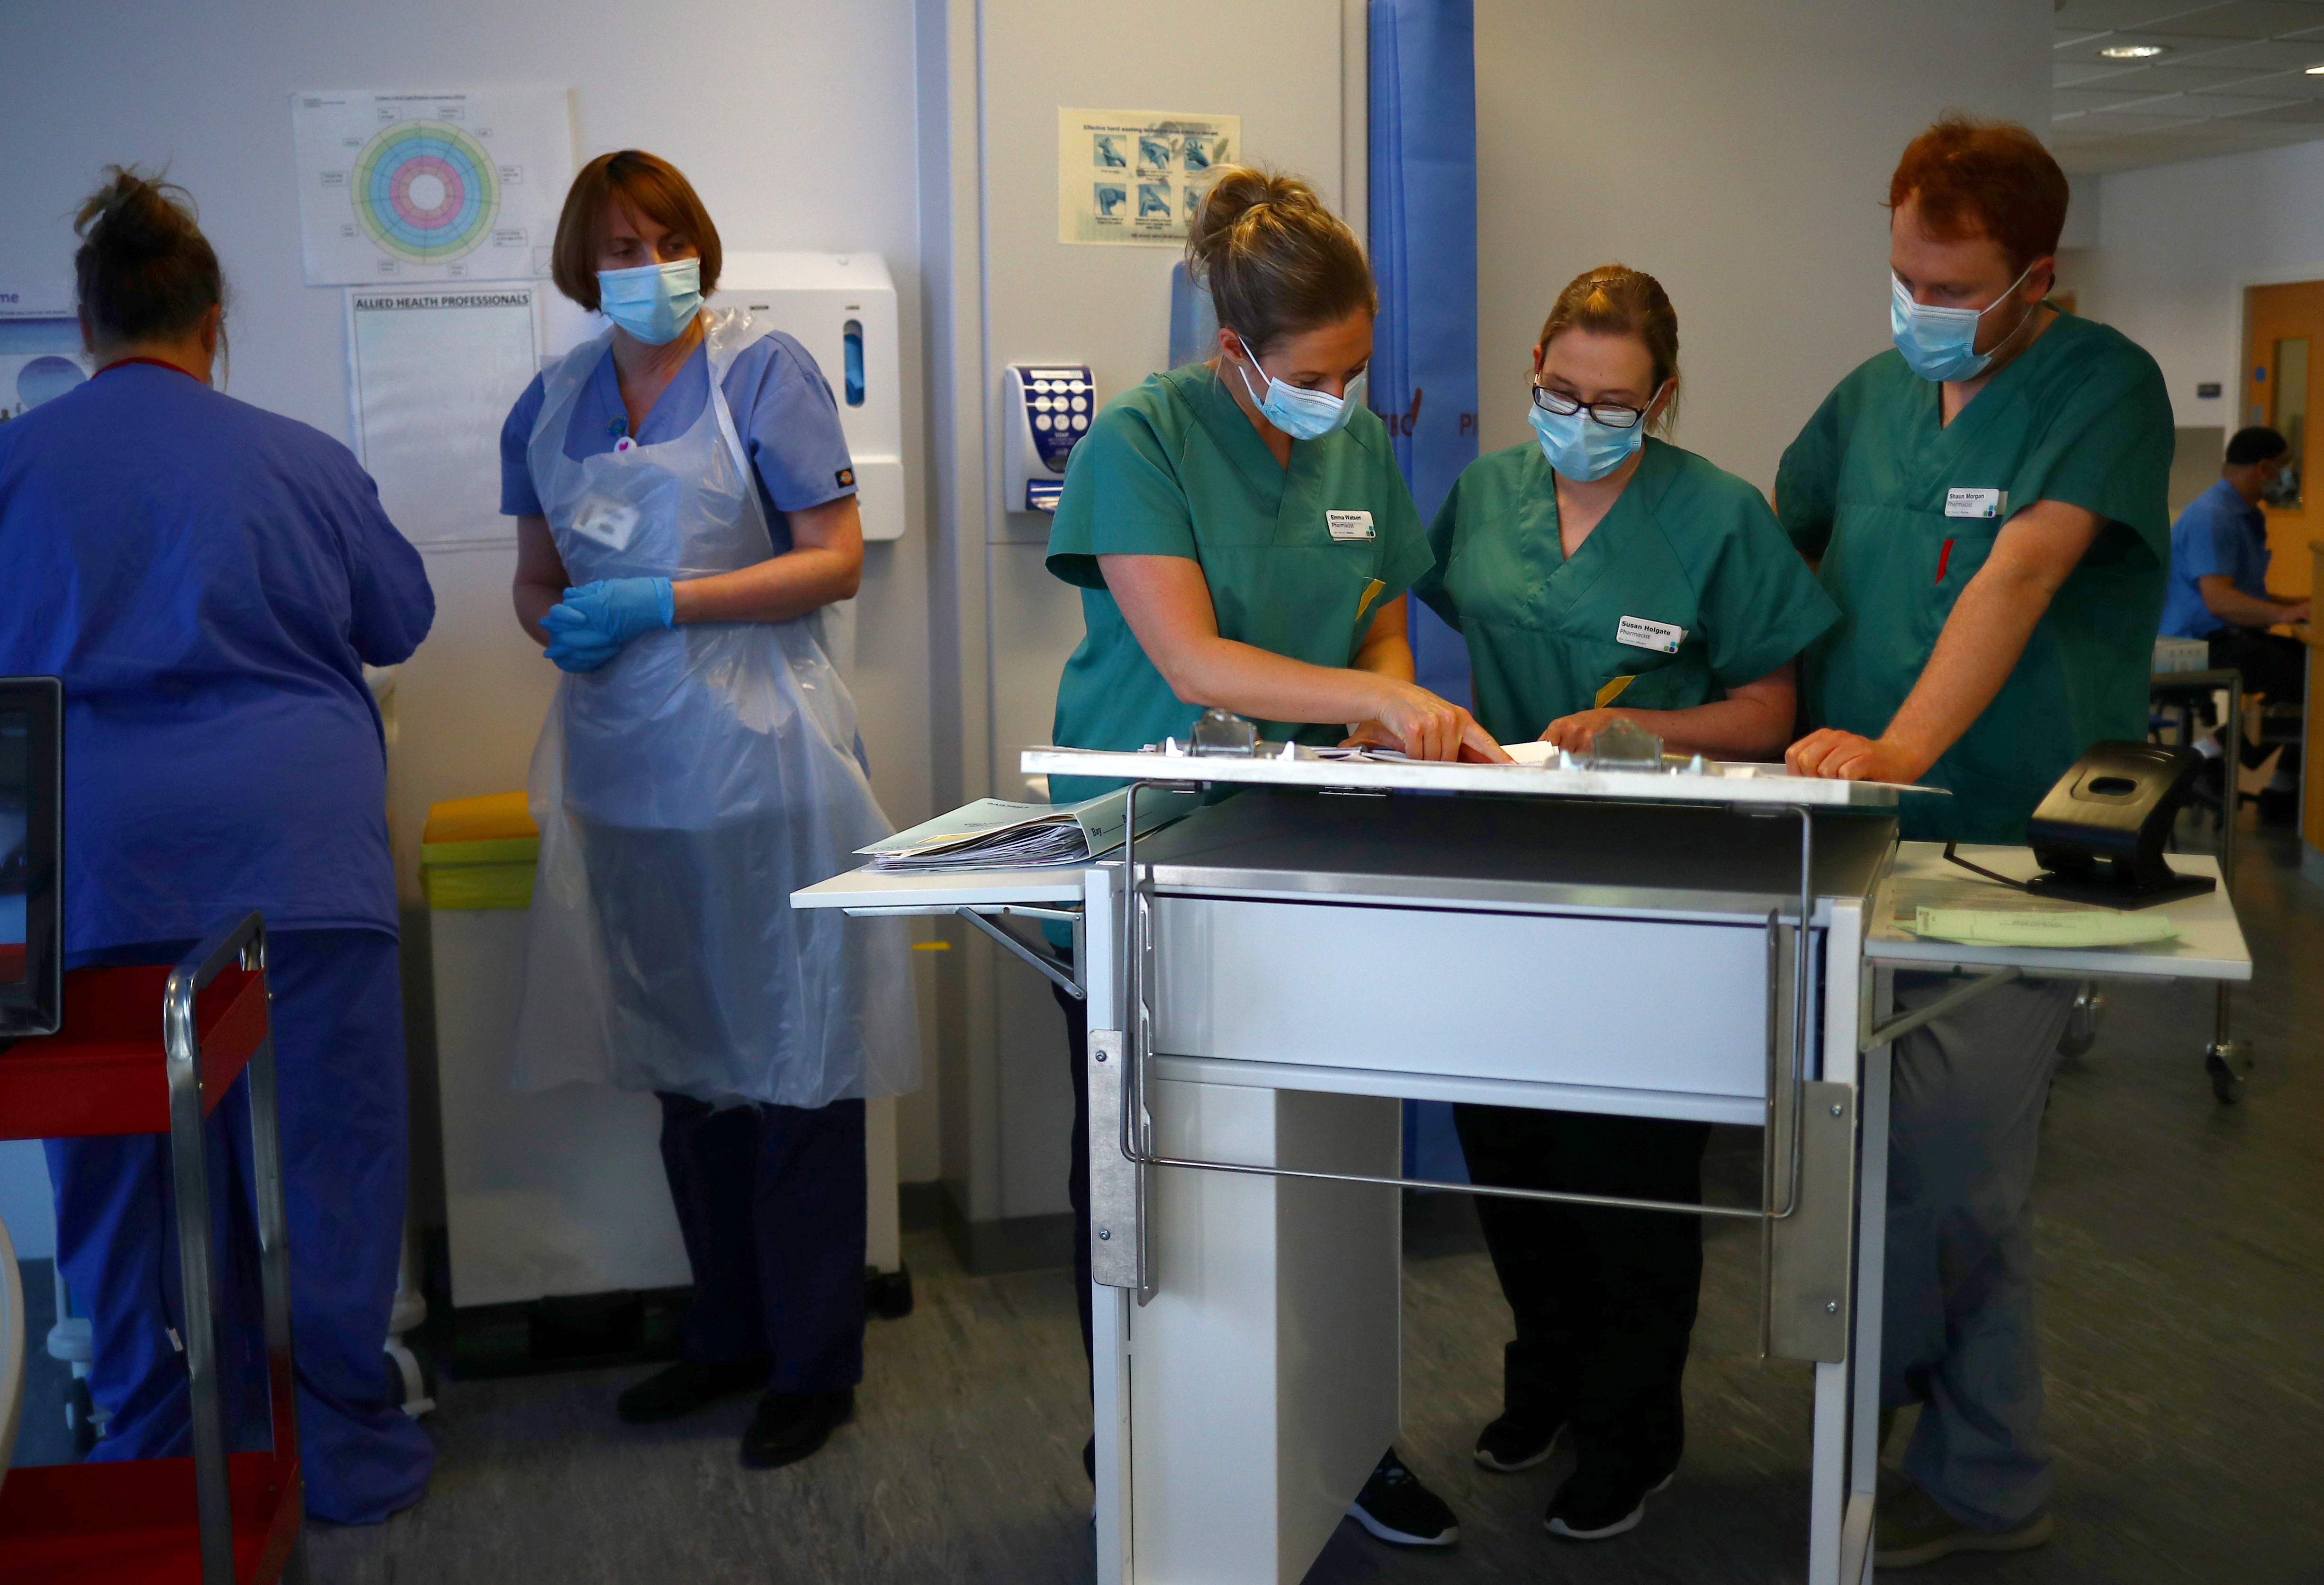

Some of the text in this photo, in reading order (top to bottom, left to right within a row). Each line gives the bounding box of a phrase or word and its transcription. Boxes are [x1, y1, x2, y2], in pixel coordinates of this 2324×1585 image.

[356, 295, 529, 309] ALLIED HEALTH PROFESSIONALS
[1620, 628, 1651, 639] Pharmacist
[1621, 621, 1671, 636] Susan Holgate
[1091, 827, 1103, 837] Bay
